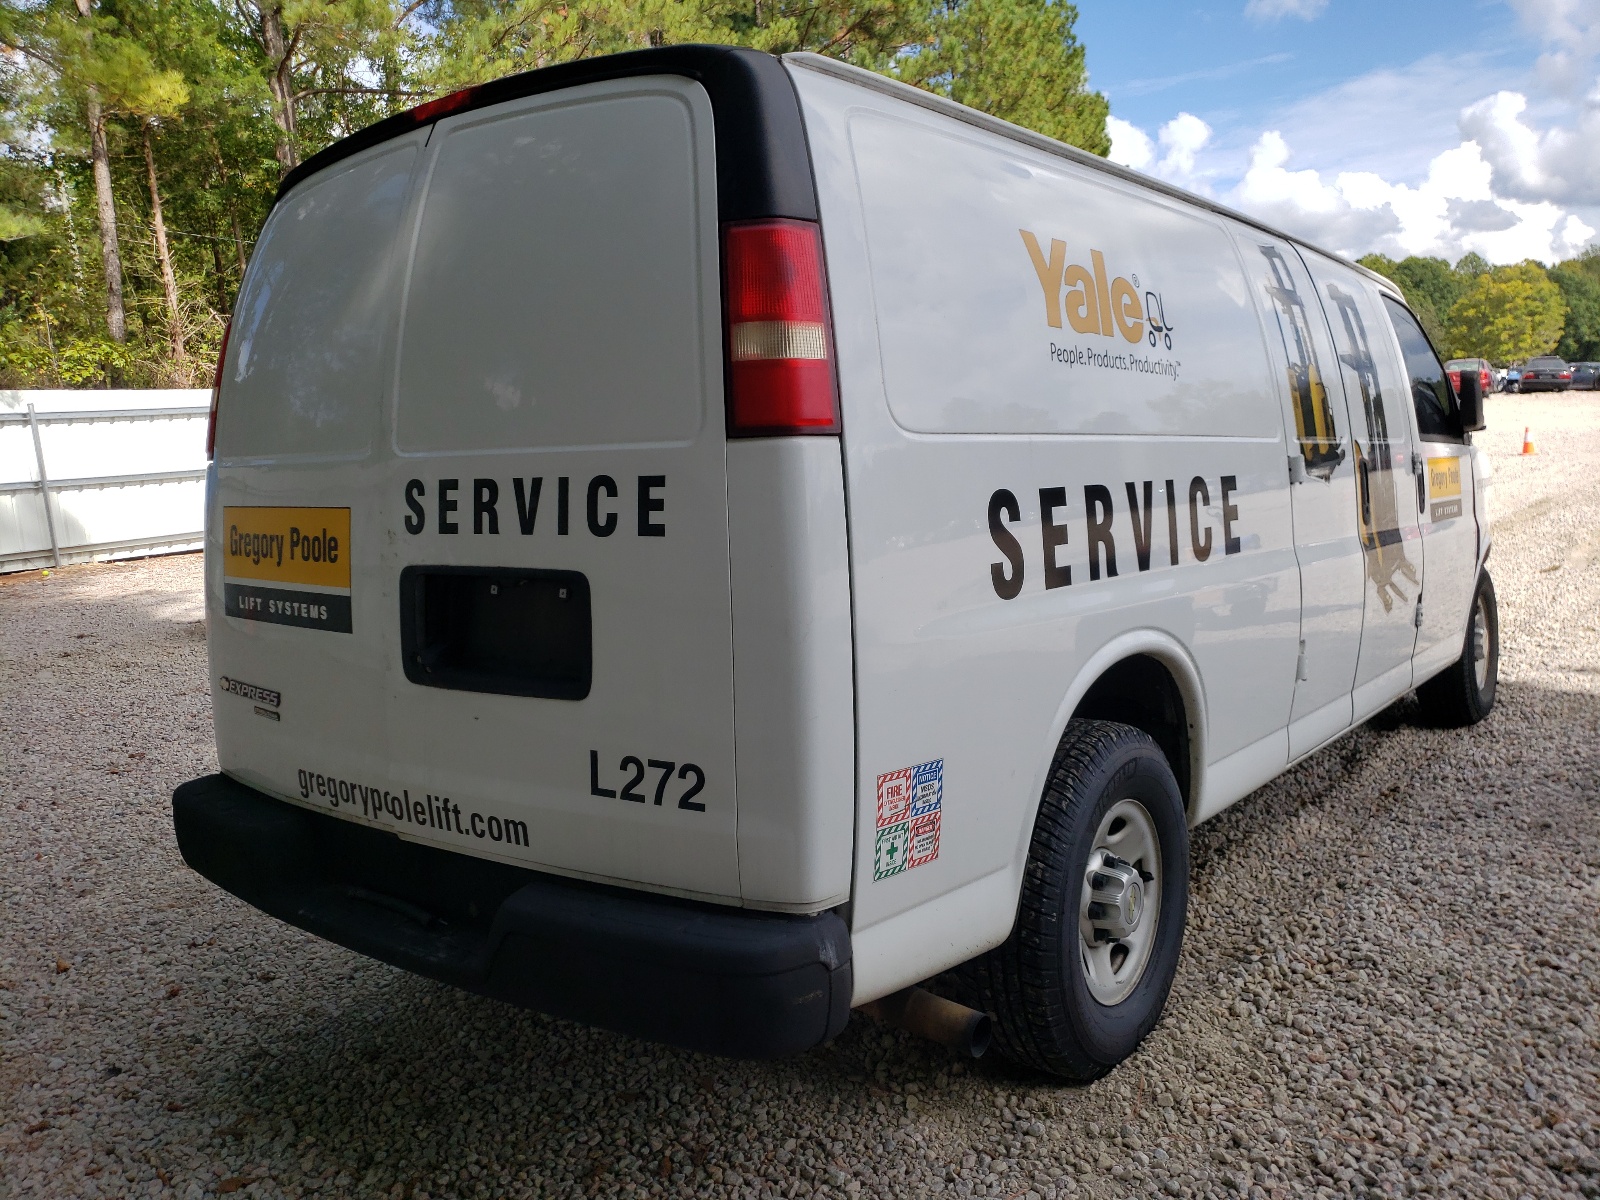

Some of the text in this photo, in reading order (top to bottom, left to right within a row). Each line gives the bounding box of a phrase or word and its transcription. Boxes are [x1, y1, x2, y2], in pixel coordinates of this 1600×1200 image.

[1018, 229, 1144, 344] Yale
[404, 474, 667, 538] SERVICE
[987, 475, 1241, 600] SERVICE
[230, 525, 339, 568] Gregory Poole
[239, 596, 328, 620] LIFT SYSTEMS
[229, 680, 279, 706] EXPRESS
[298, 767, 530, 848] gregorypoolelift.com
[590, 749, 706, 813] L272
[887, 783, 903, 800] FIRE
